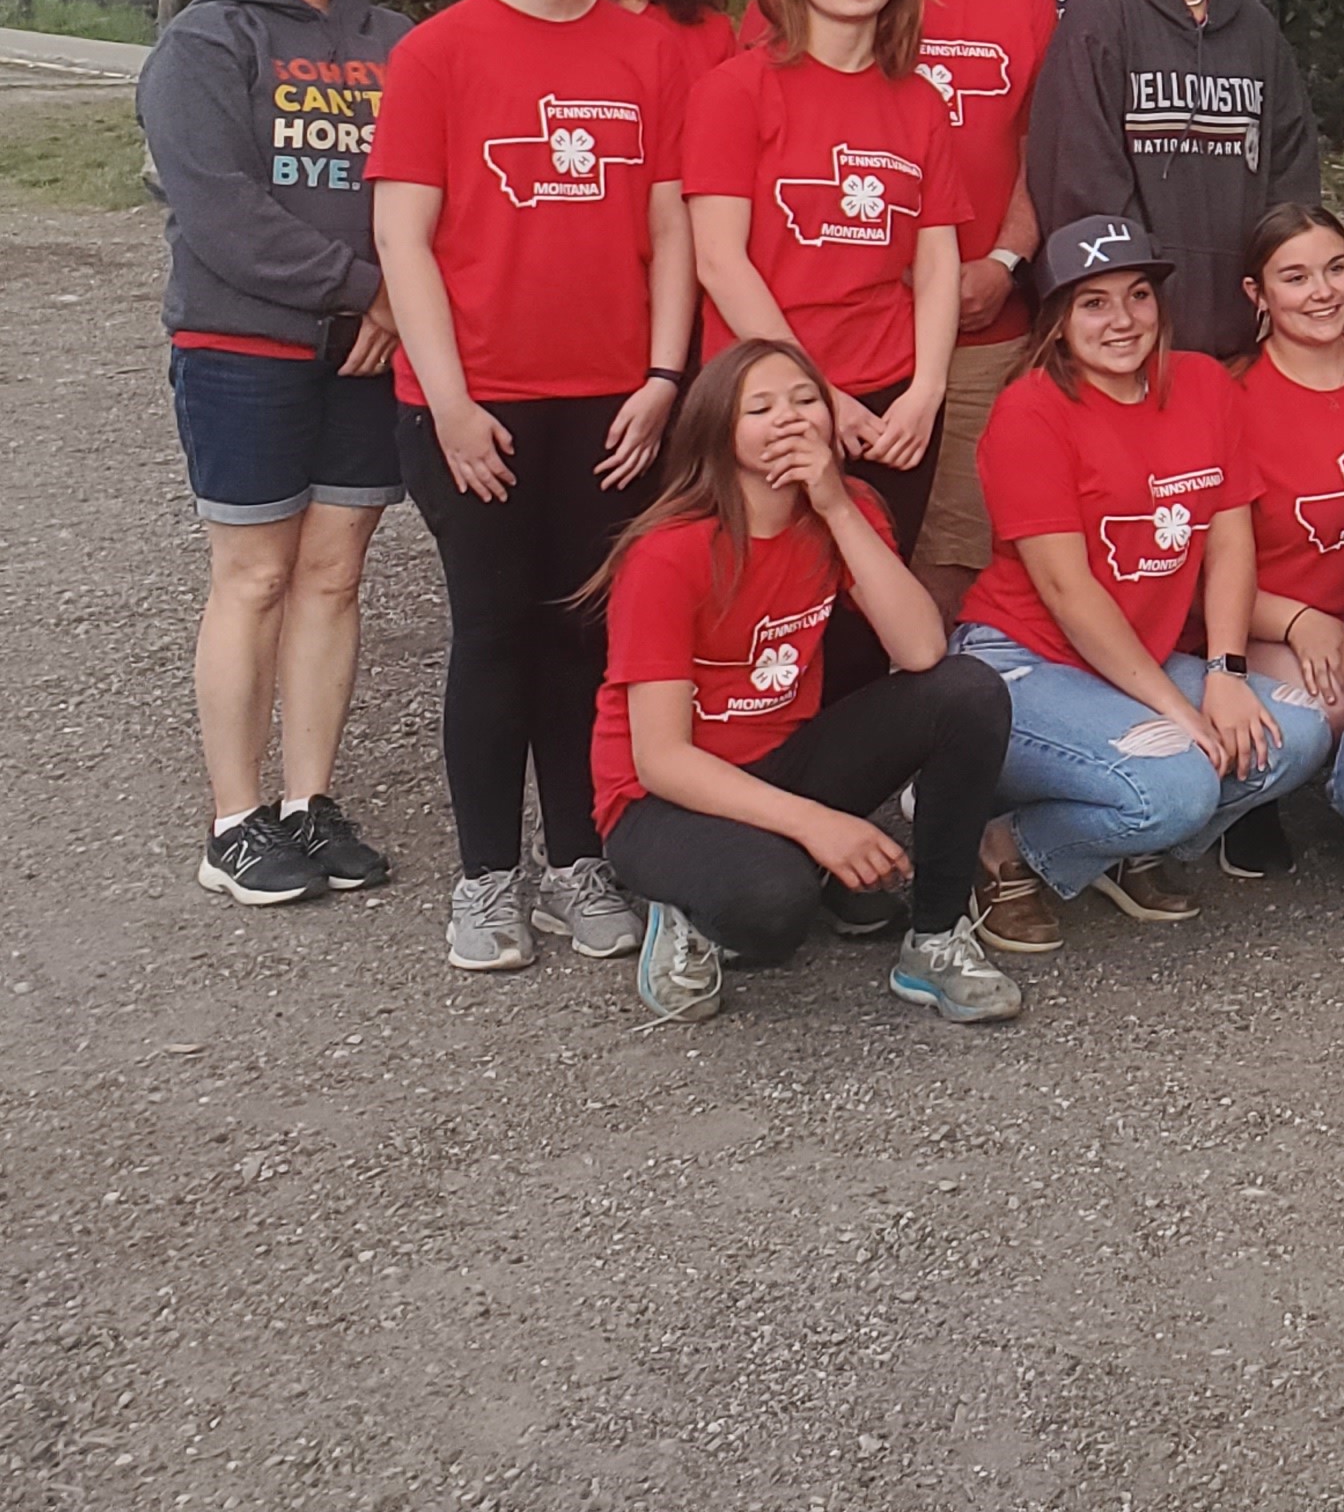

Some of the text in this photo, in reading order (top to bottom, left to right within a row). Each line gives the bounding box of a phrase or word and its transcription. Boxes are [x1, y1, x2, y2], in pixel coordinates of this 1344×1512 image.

[920, 44, 998, 58] ENNSYLVANIA
[274, 118, 376, 153] HORS
[1207, 140, 1242, 156] PARK
[272, 155, 361, 190] BYE.
[821, 223, 885, 239] MONTANA
